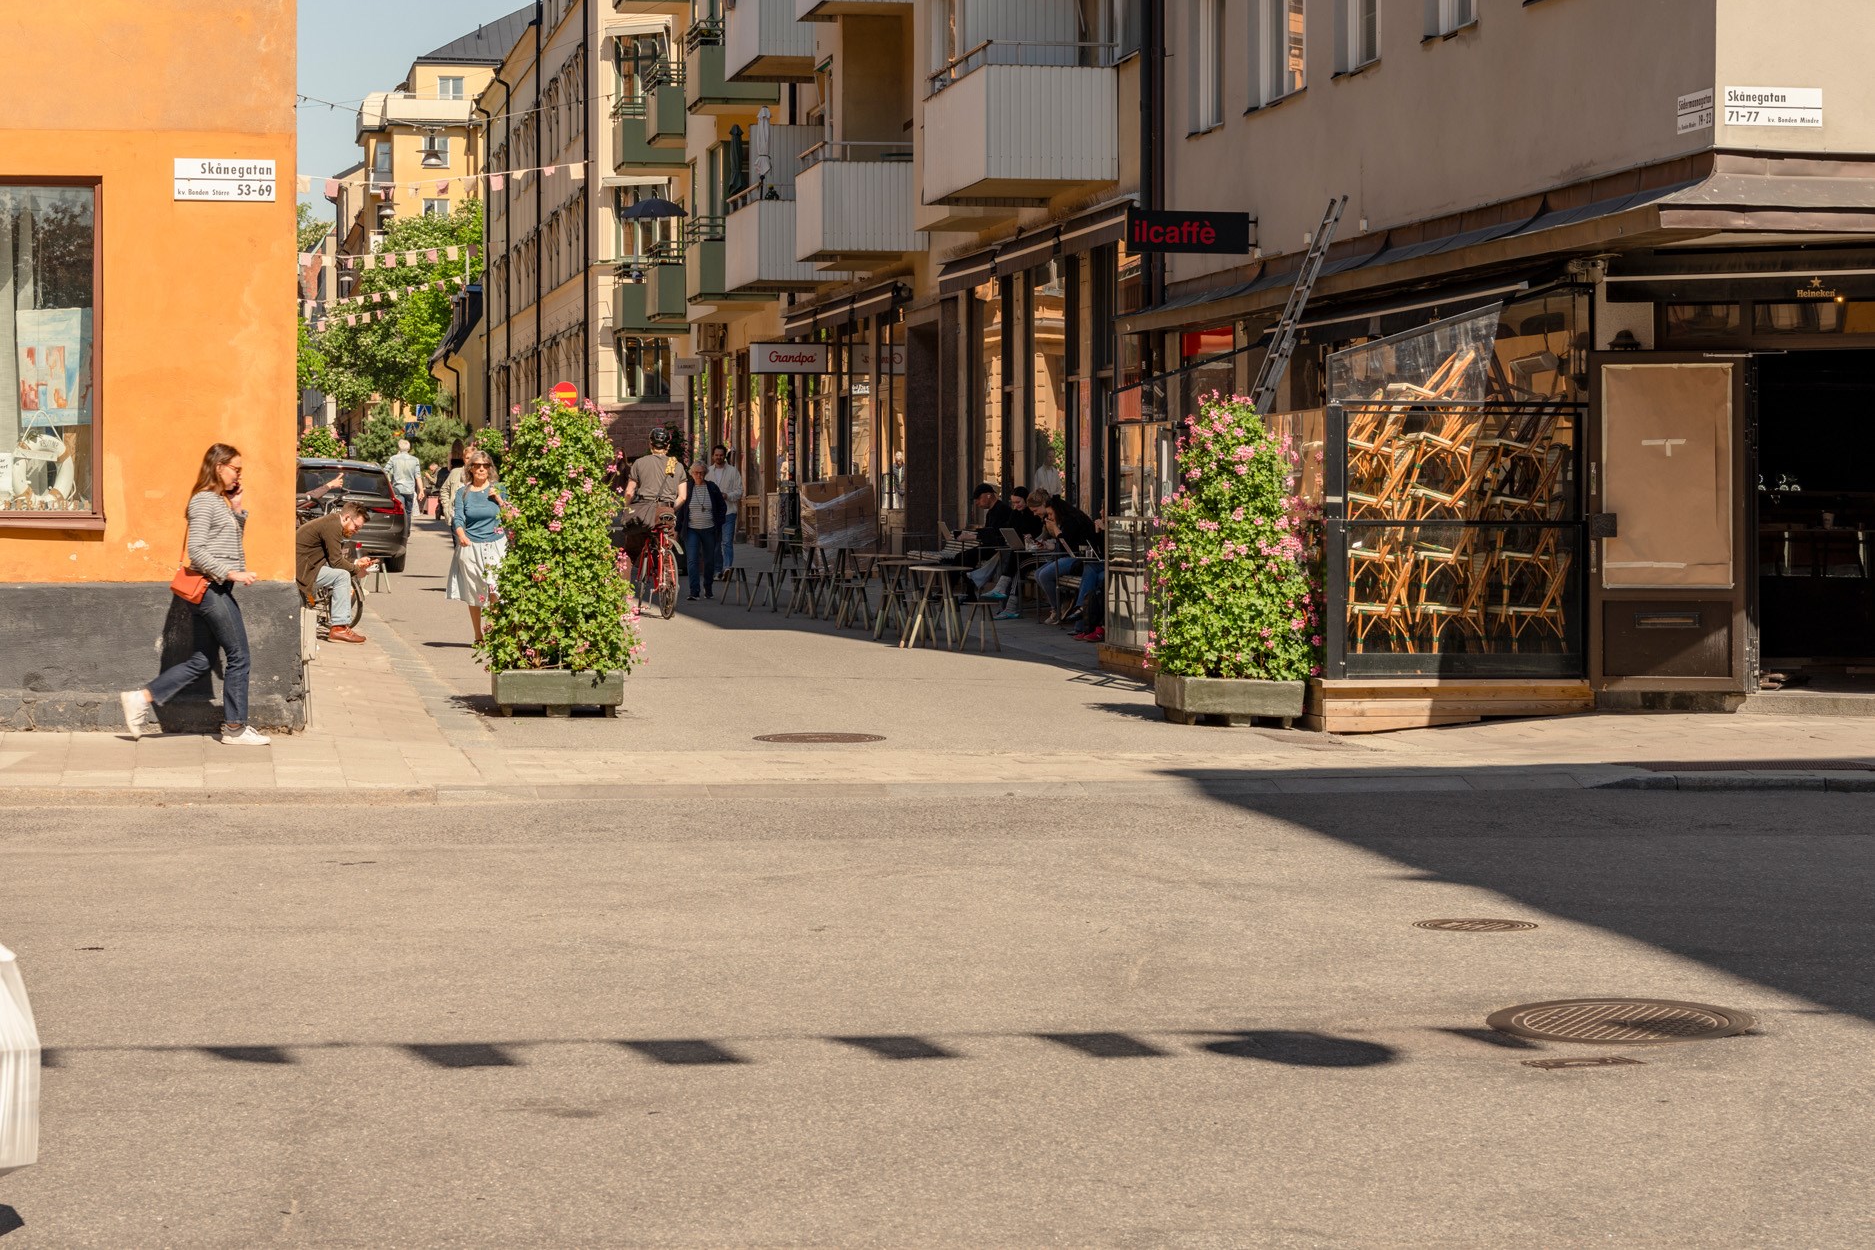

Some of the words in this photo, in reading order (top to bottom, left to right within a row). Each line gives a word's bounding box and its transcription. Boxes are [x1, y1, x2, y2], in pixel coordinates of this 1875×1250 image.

[1728, 90, 1786, 105] Skånegatan
[1728, 111, 1759, 122] 71-77
[201, 162, 272, 178] Skånegatan
[237, 184, 272, 196] 53-69
[1134, 220, 1216, 244] ilcaffè
[1797, 289, 1835, 297] Heineken
[769, 351, 816, 365] Grandpa
